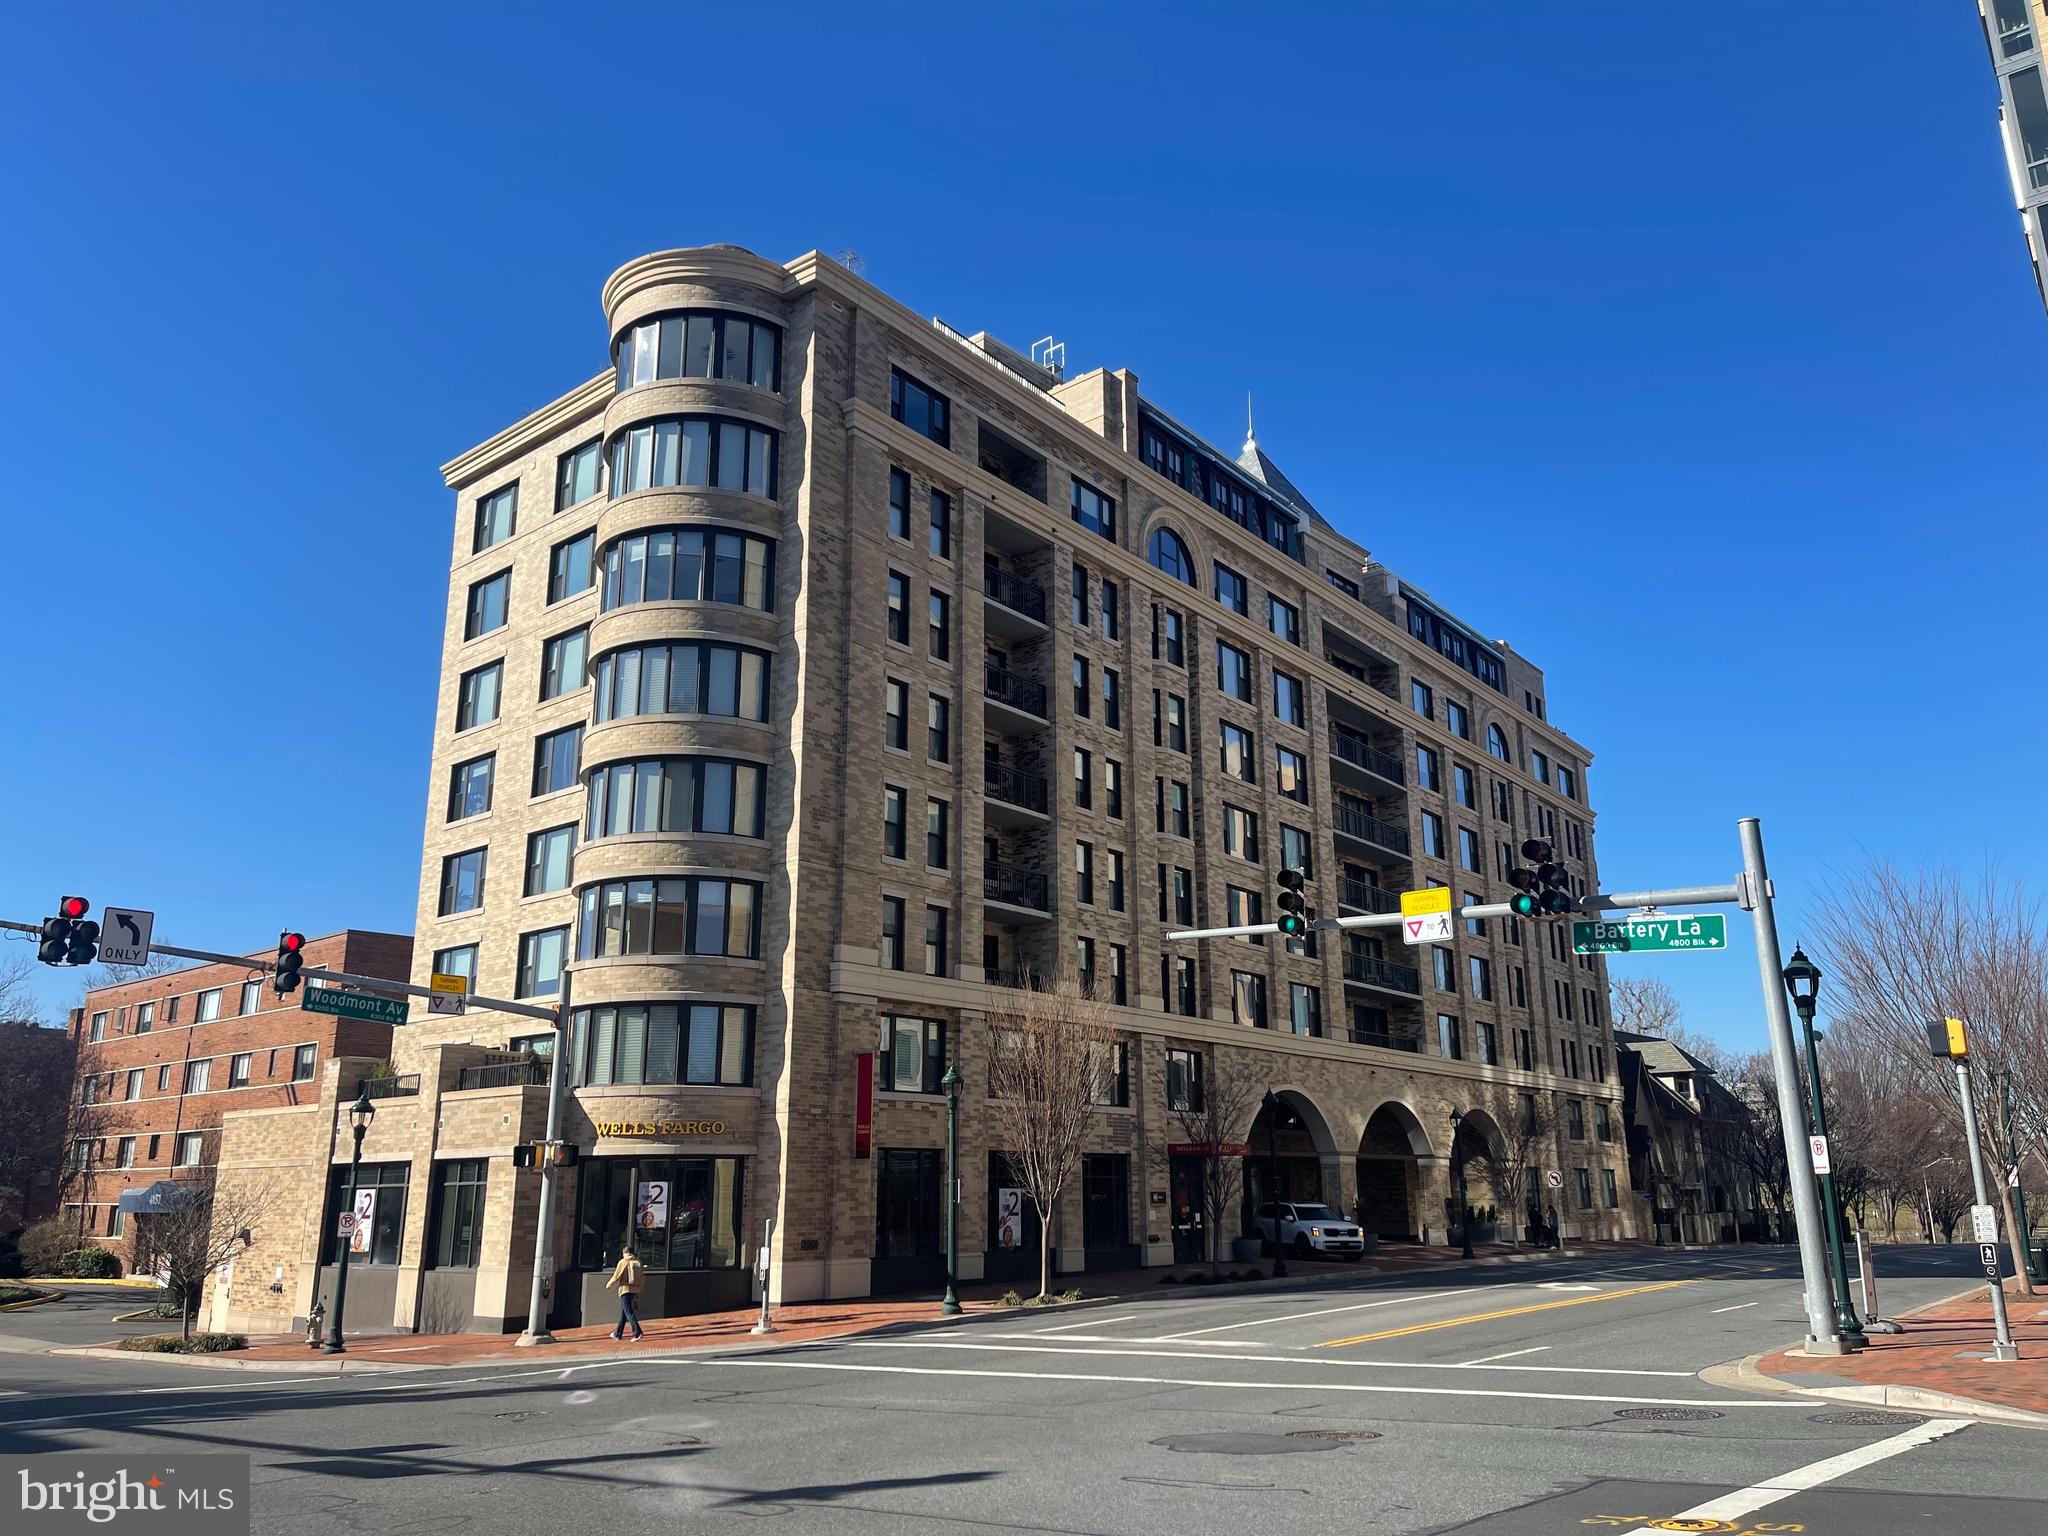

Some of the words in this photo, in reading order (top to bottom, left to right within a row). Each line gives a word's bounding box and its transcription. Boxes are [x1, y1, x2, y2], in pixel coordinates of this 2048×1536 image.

[1594, 922, 1669, 942] Battery
[1678, 919, 1701, 936] La
[105, 947, 141, 960] ONLY
[1669, 938, 1690, 947] 4800
[310, 989, 382, 1012] Woodmont
[386, 1003, 404, 1016] Av
[596, 1121, 656, 1136] WELLS
[660, 1121, 725, 1135] FARGO
[650, 1184, 664, 1205] 2
[1008, 1191, 1019, 1216] 2
[361, 1193, 373, 1219] 2
